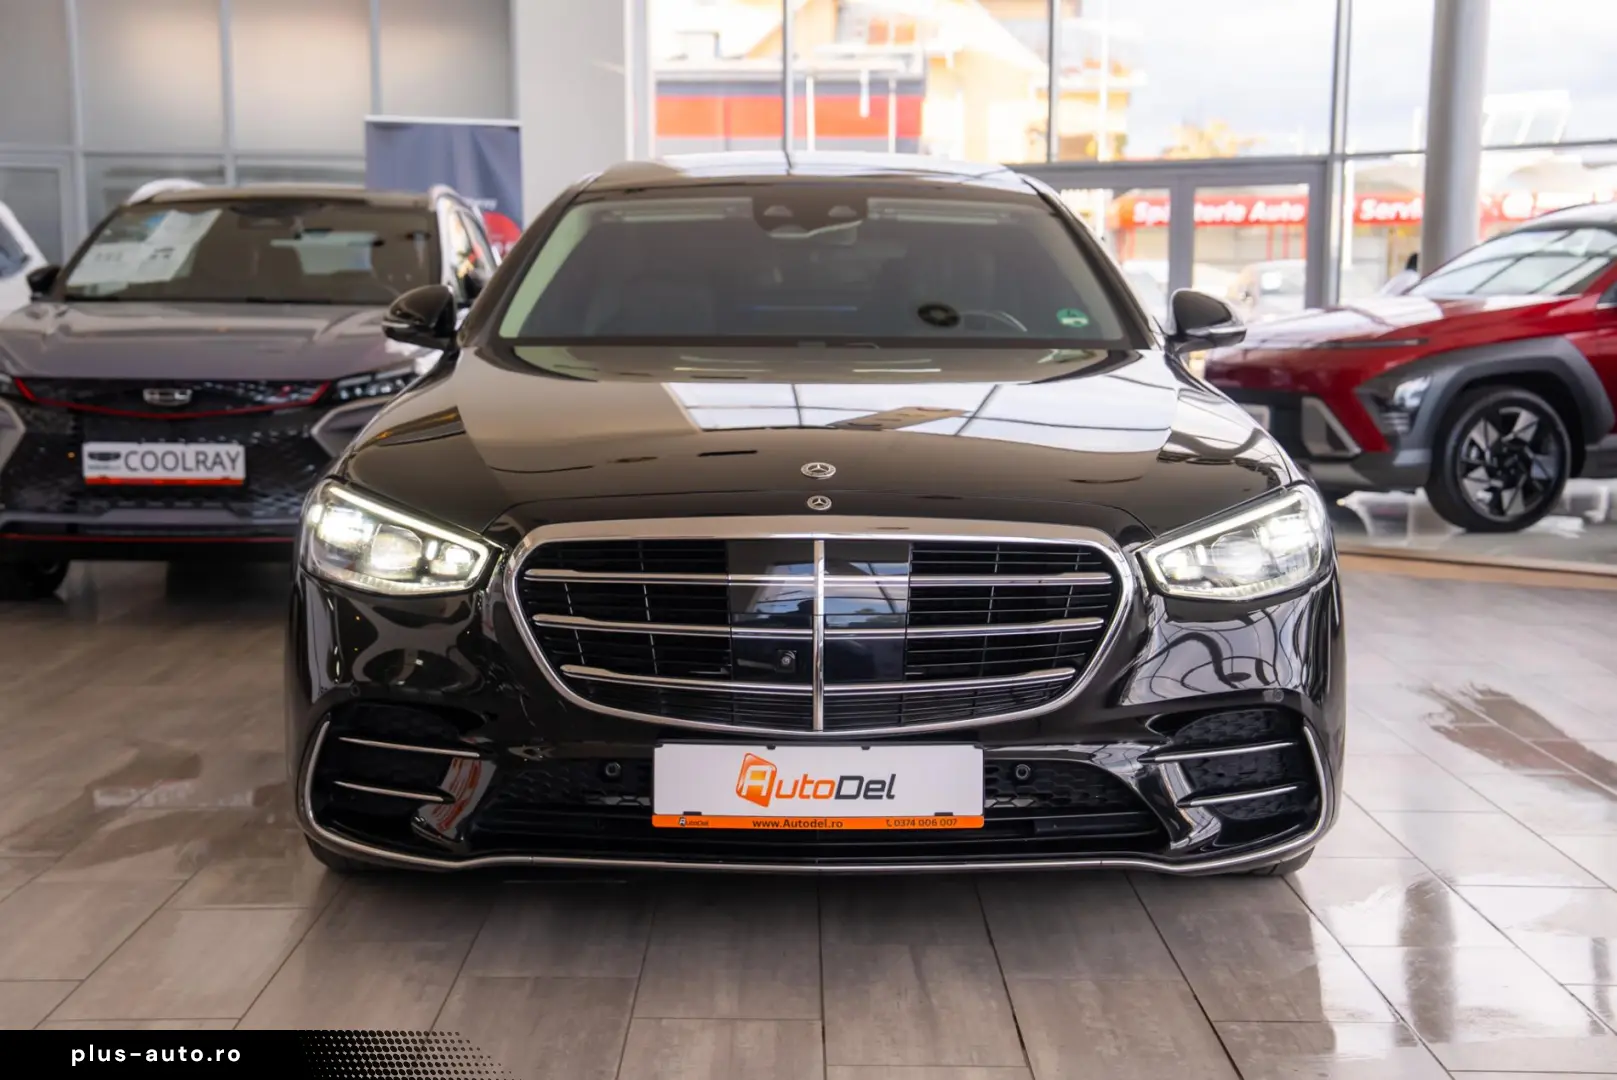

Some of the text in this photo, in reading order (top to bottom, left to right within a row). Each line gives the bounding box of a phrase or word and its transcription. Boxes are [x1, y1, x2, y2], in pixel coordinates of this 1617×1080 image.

[1248, 200, 1306, 223] Auto
[123, 450, 241, 472] COOLRAY
[738, 760, 897, 801] AutoDel
[752, 818, 844, 829] www.Autodel.ro
[894, 818, 916, 828] 0374
[939, 818, 958, 828] 007
